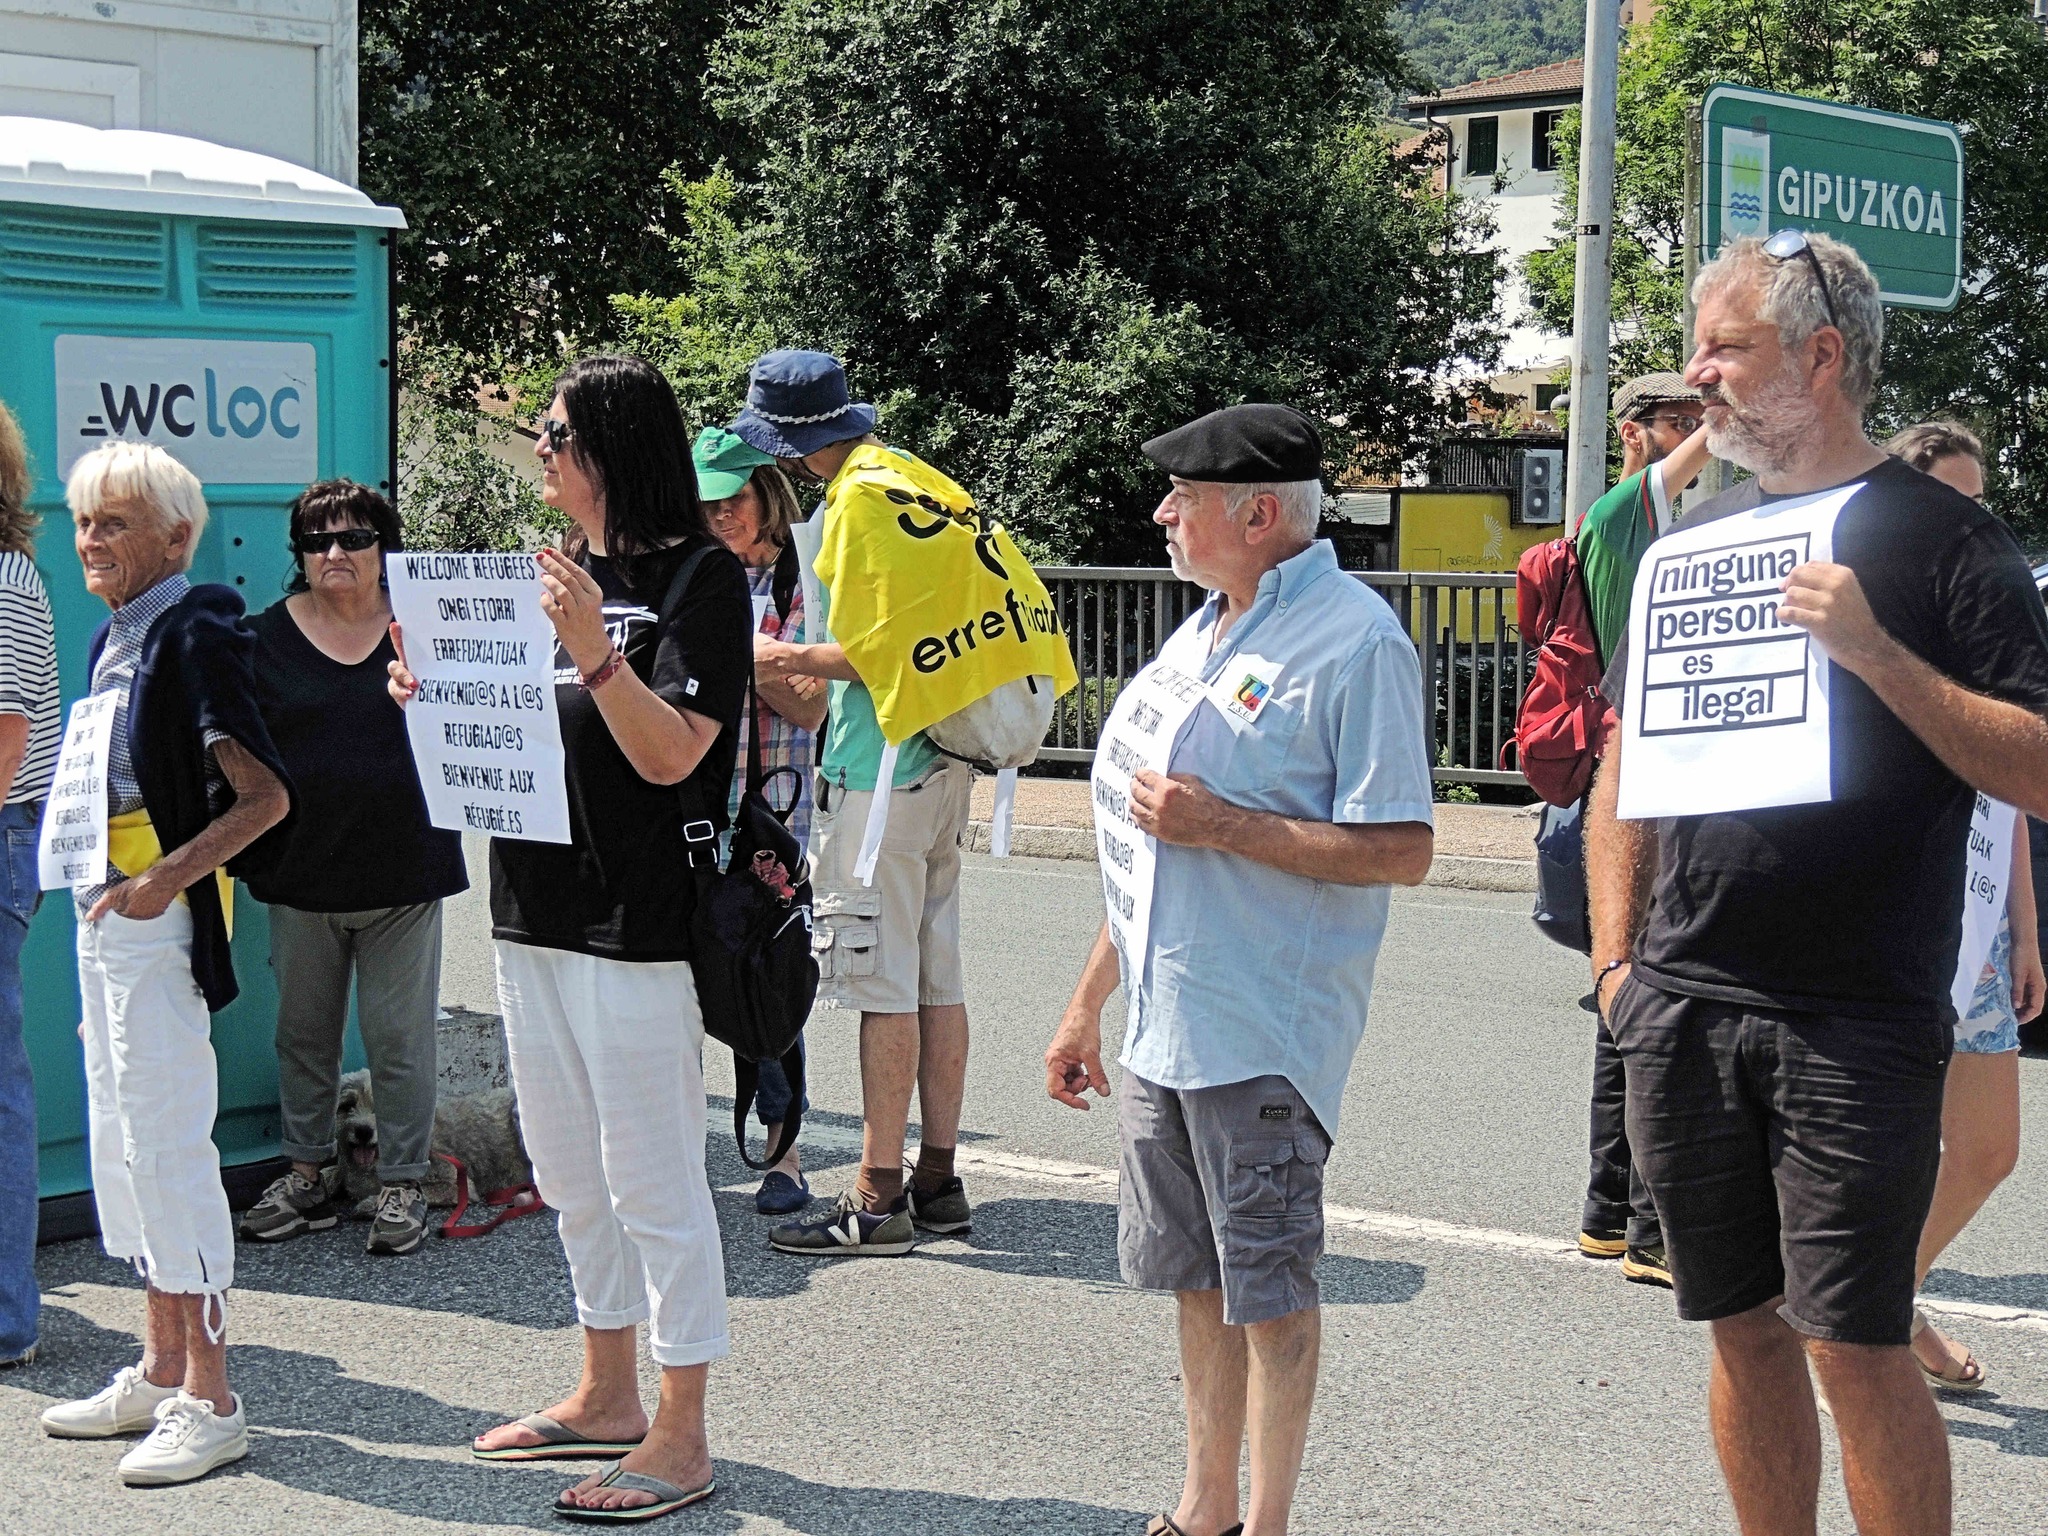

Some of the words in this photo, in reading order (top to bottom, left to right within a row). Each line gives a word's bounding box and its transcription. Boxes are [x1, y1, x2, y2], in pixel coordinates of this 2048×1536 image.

[1777, 166, 1946, 236] GIPUZKOA
[405, 556, 471, 580] WELCOME
[473, 556, 536, 580] REFUGEES
[1659, 548, 1797, 597] ninguna
[437, 597, 471, 622] ONGI
[474, 597, 516, 623] ETORRI
[1657, 599, 1792, 649] person
[432, 638, 528, 666] ERREFUXIATUAK
[1682, 653, 1714, 675] es
[418, 678, 496, 708] BIENVENID@S
[500, 684, 511, 709] A
[514, 683, 544, 711] L@S
[1682, 678, 1774, 725] ilegal
[444, 722, 523, 751] REFUGIAD@S
[442, 763, 505, 792] BIENVENUE
[509, 769, 536, 793] AUX
[463, 802, 523, 835] RÉFUGIÉ.ES
[1969, 828, 1994, 862] UAK
[1969, 870, 1997, 905] L@S
